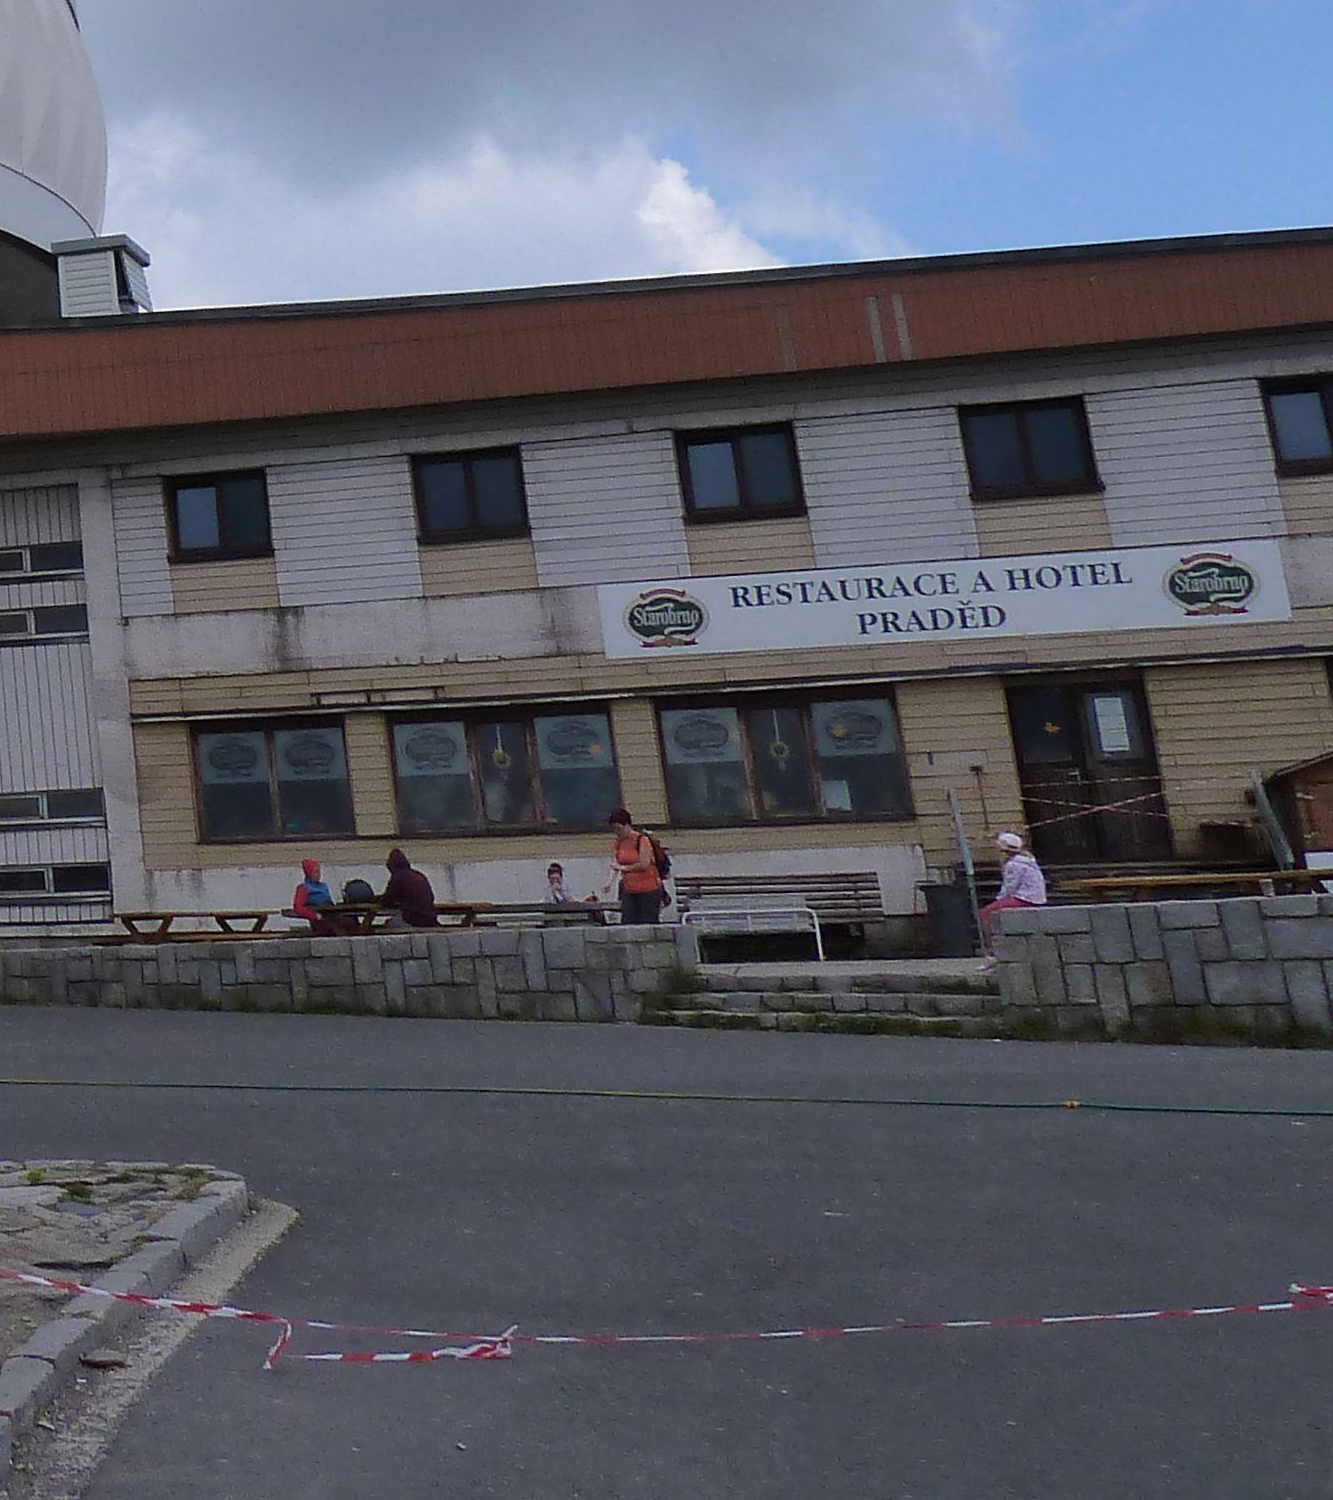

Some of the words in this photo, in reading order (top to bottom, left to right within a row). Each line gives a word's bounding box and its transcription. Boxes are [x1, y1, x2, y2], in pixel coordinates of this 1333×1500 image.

[729, 571, 961, 608] RESTAURACE
[972, 570, 995, 594] A
[1006, 561, 1133, 591] HOTEL
[1175, 570, 1249, 598] Starobrno
[633, 605, 699, 631] Starobrno
[856, 601, 1007, 636] PRADĚD
